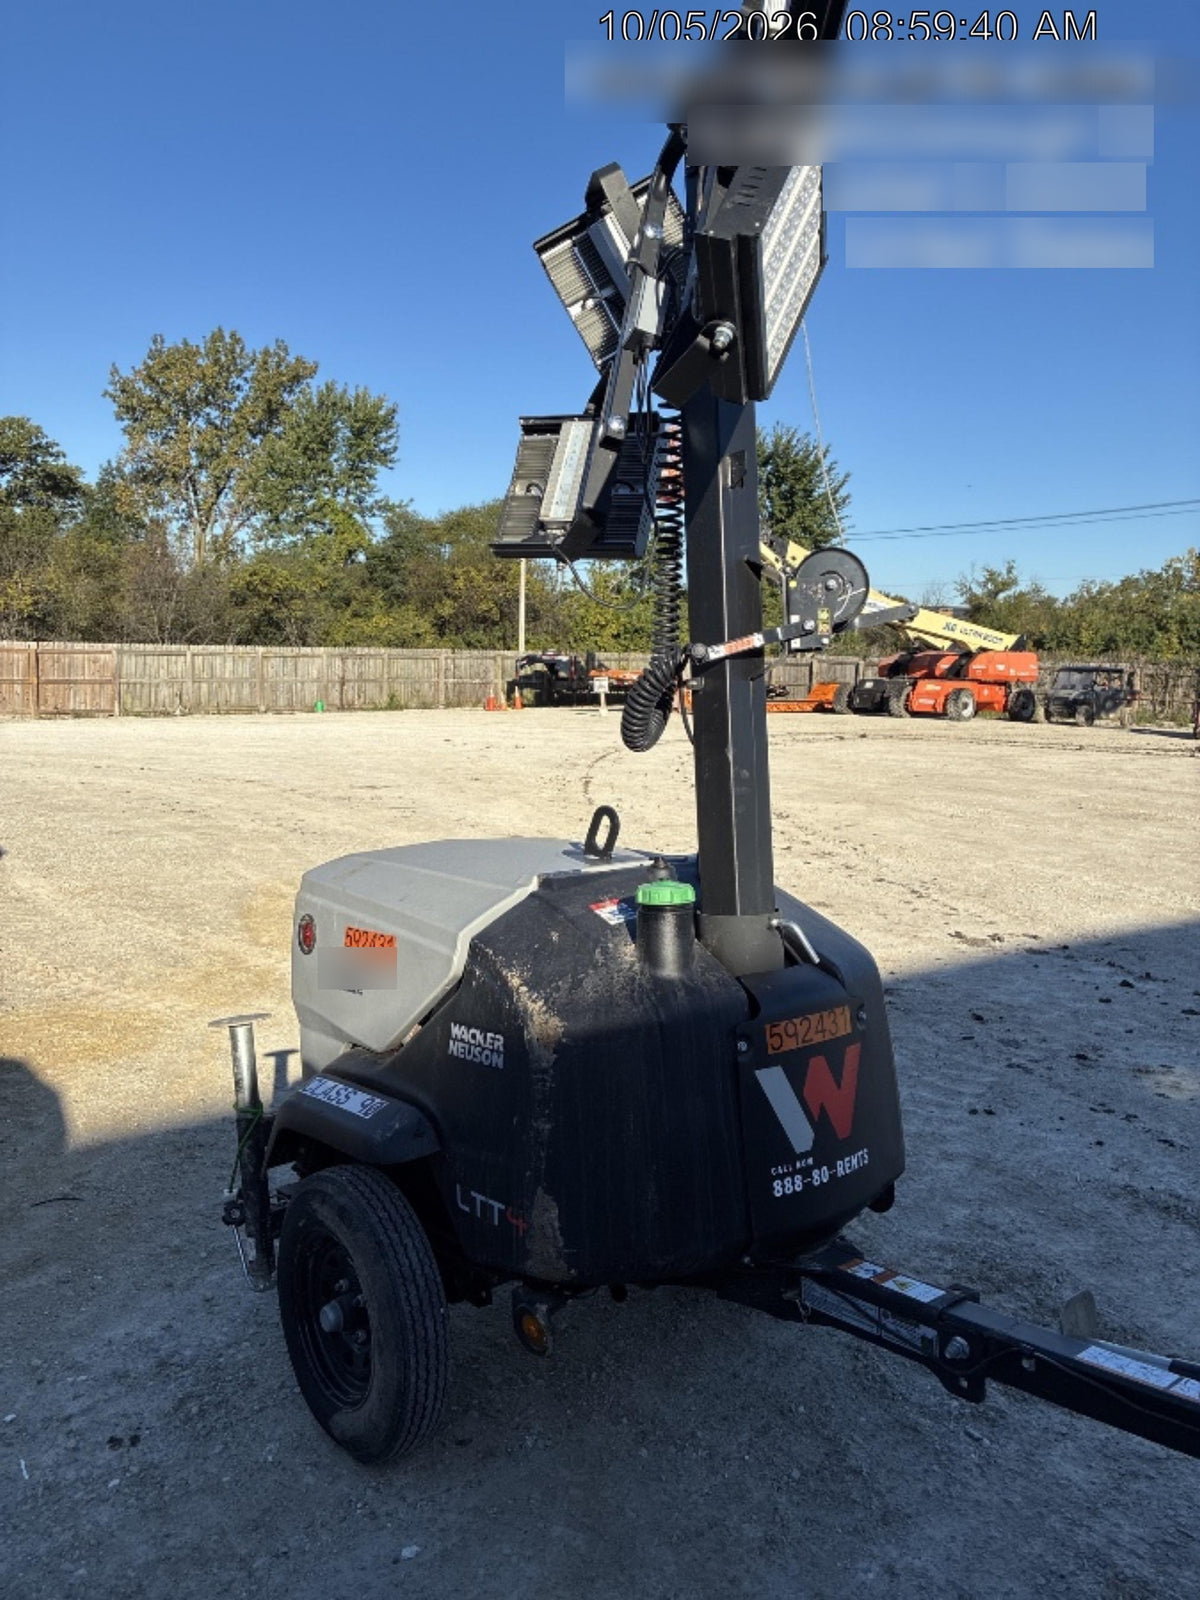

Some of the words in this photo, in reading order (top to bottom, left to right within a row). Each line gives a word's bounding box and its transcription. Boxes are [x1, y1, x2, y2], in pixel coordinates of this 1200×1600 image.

[450, 1021, 504, 1052] WACKER
[769, 1005, 848, 1051] 592431
[448, 1039, 504, 1069] NEUSON
[773, 1147, 869, 1198] 888-80-RENTS
